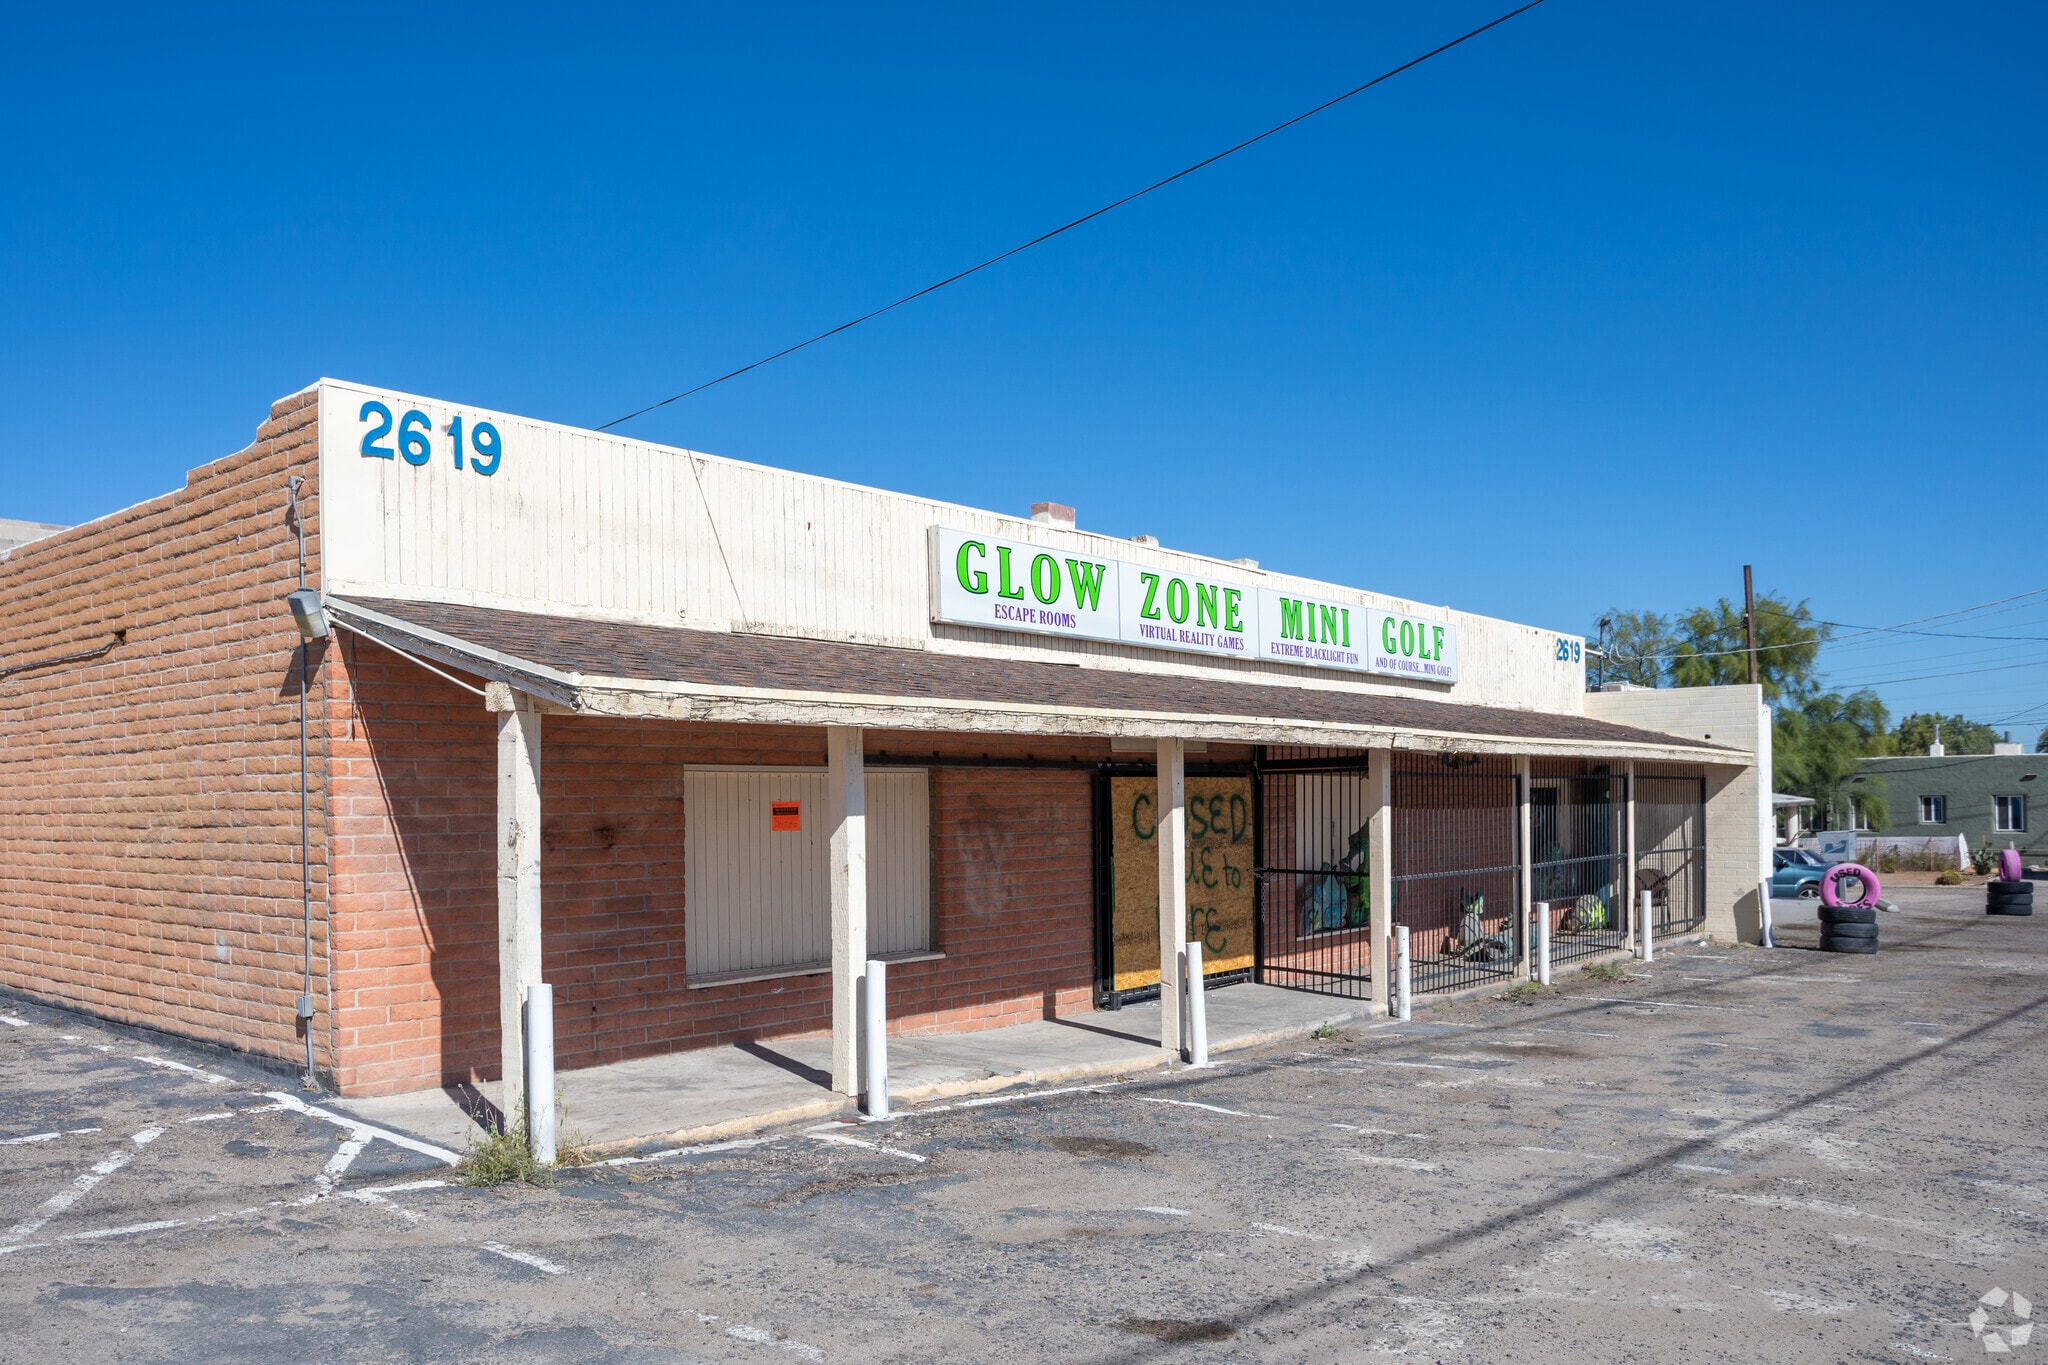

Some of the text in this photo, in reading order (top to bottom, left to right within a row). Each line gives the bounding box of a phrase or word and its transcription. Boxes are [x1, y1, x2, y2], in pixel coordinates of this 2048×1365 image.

[359, 401, 502, 476] 2619
[956, 540, 1444, 661] GLOW ZONE MINI GOLF
[994, 603, 1076, 628] ESCAPE ROOMS
[1139, 623, 1244, 651] VIRTUAL REALITY GAMES
[1556, 637, 1580, 664] 2619
[1271, 642, 1359, 665] EXTREME BLACKLIGHT FUN
[1375, 657, 1388, 669] AND
[1389, 658, 1397, 670] OF
[1133, 793, 1247, 843] CSED
[1830, 868, 1861, 882] USED
